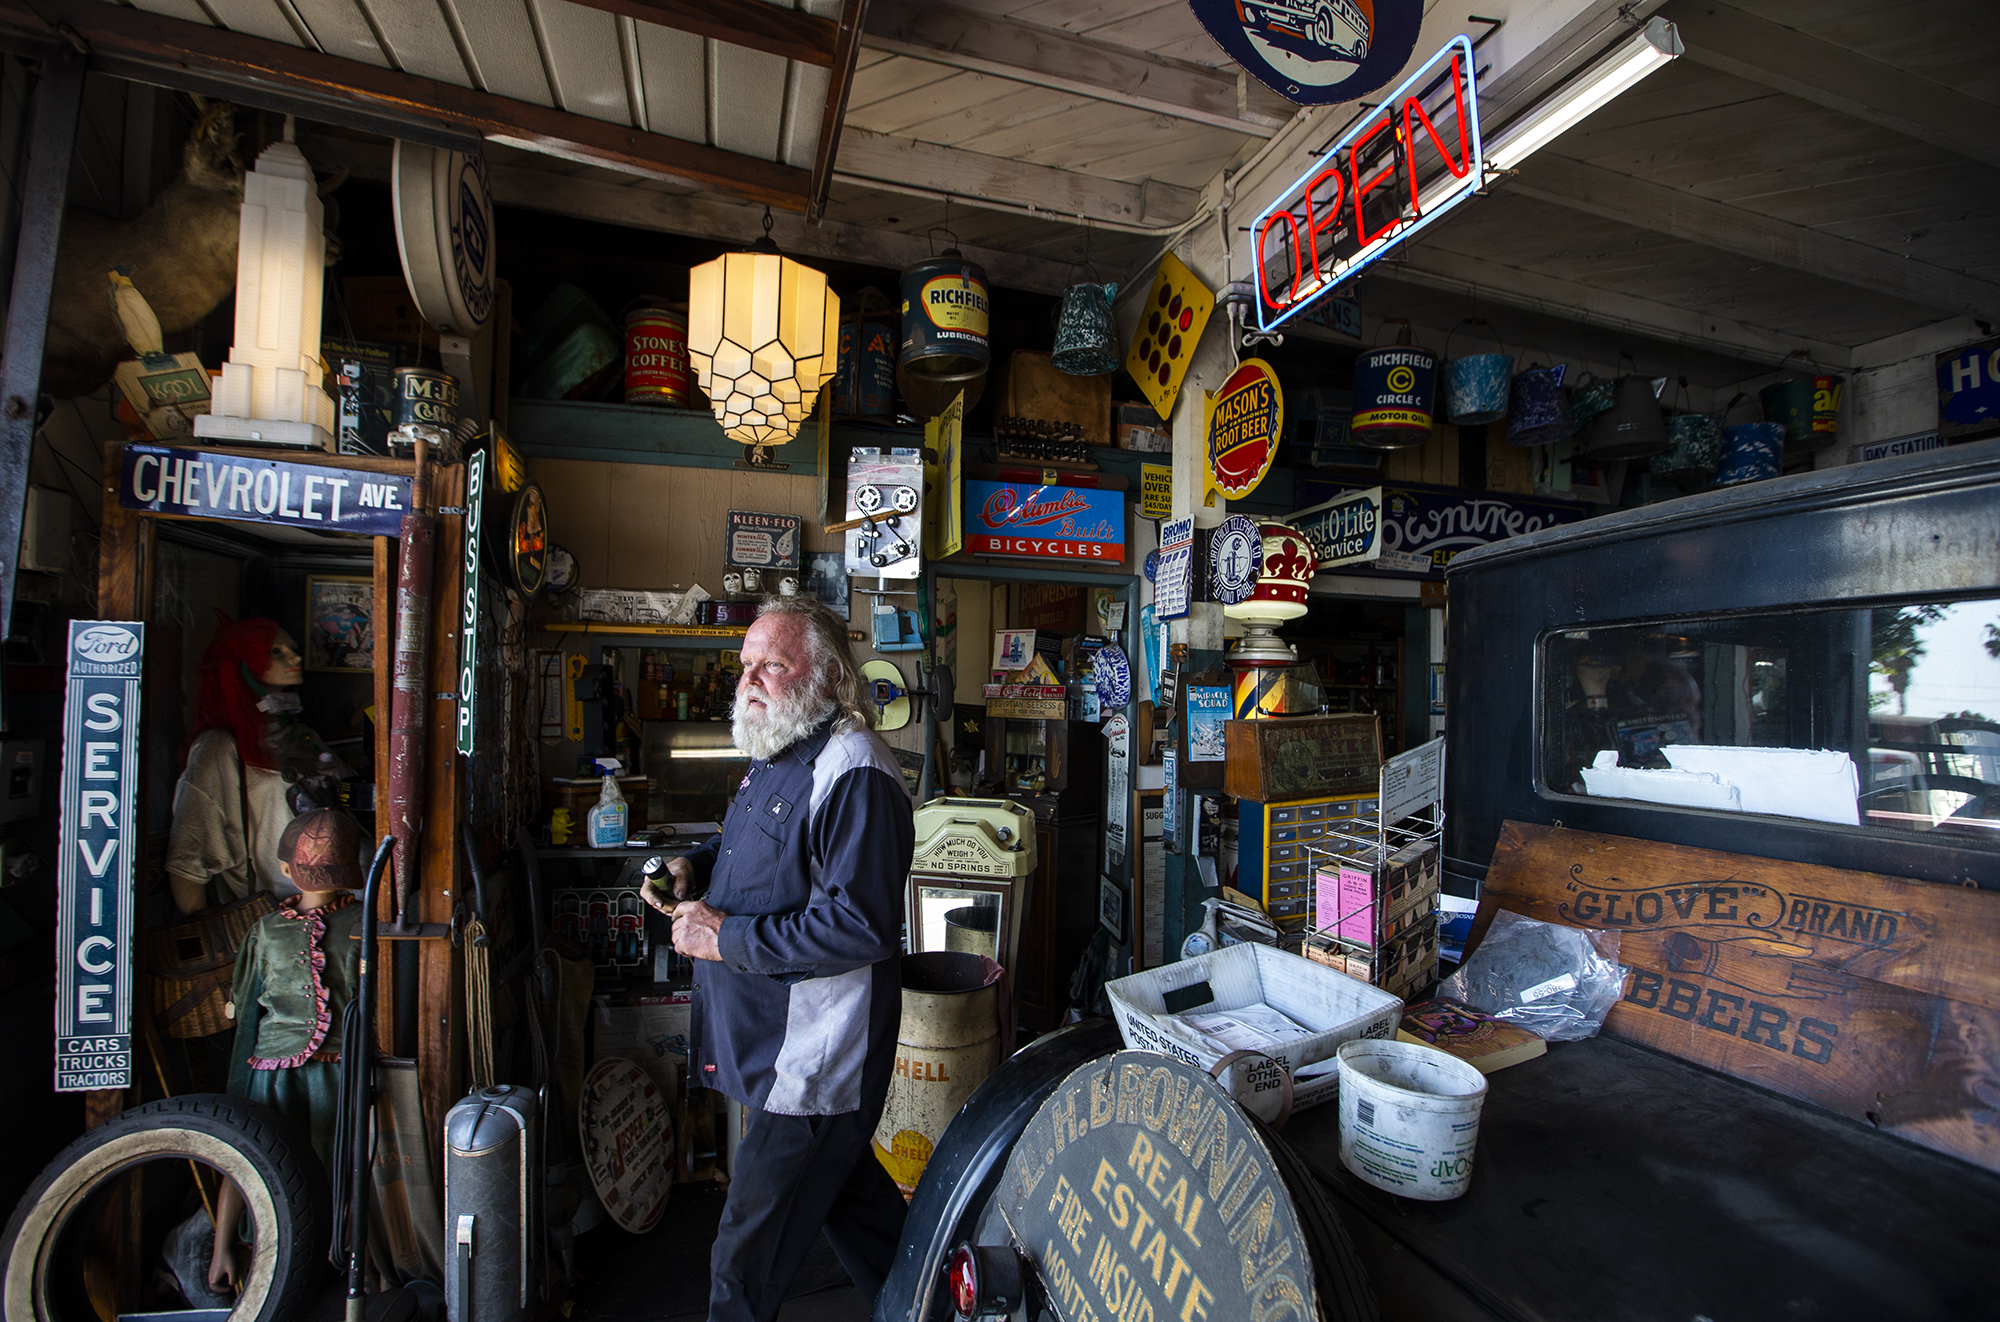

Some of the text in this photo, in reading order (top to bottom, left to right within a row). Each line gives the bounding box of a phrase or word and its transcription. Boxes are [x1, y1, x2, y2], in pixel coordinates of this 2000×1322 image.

[1259, 55, 1469, 309] OPEN
[633, 336, 686, 358] STONE'S
[937, 332, 988, 346] LUBRICANTS
[632, 354, 685, 373] COFFEE
[1370, 353, 1433, 369] RICHFIELD
[148, 378, 204, 399] KOOL
[1215, 383, 1269, 429] MASON'S
[1376, 394, 1421, 406] CIRCLE C
[1215, 408, 1269, 435] OLD FASHIONED
[1370, 412, 1425, 423] MOTOR OIL
[1216, 416, 1268, 453] ROOT BEER
[133, 453, 402, 521] CHEVROLET AVE.
[1145, 472, 1172, 483] VEHICL
[1145, 482, 1170, 493] OVER
[976, 488, 1091, 528] Columbia
[1055, 517, 1114, 540] Built
[1163, 518, 1191, 540] BROMO
[1381, 496, 1560, 552] owntree's
[990, 538, 1102, 556] BICYCLES
[1162, 532, 1190, 546] SELTZER
[1317, 537, 1364, 560] Service
[459, 461, 480, 741] BUS STOP
[78, 631, 135, 654] Ford
[73, 660, 137, 674] AUTHORIZED
[994, 700, 1056, 709] EGYPTIAN SEERESS
[1196, 691, 1229, 700] MIRACLE
[1198, 700, 1229, 708] SQUAD
[1321, 738, 1373, 754] DYES
[76, 693, 122, 1024] SERVICE
[934, 838, 988, 859] HOW MUCH DO YOU
[947, 863, 990, 872] SPRINGS
[1343, 873, 1367, 883] GRIFFIN
[1787, 899, 1899, 946] BRAND
[1348, 963, 1367, 972] GRIFFIN
[1625, 968, 1838, 1064] BBERS
[1360, 1018, 1390, 1039] LABEL
[67, 1038, 120, 1052] CARS
[1126, 1013, 1200, 1067] UNITED STATES
[61, 1053, 126, 1071] TRUCKS
[896, 1057, 950, 1081] HELL
[1250, 1056, 1290, 1073] LABEL
[61, 1071, 126, 1087] TRACTORS
[1247, 1066, 1290, 1083] OTHER
[1255, 1079, 1281, 1092] END
[1294, 1090, 1318, 1102] NITED
[612, 1113, 645, 1182] JASPER
[1128, 1132, 1203, 1247] REAL
[1048, 1173, 1093, 1258] FIRE
[1091, 1157, 1215, 1322] ESTATE
